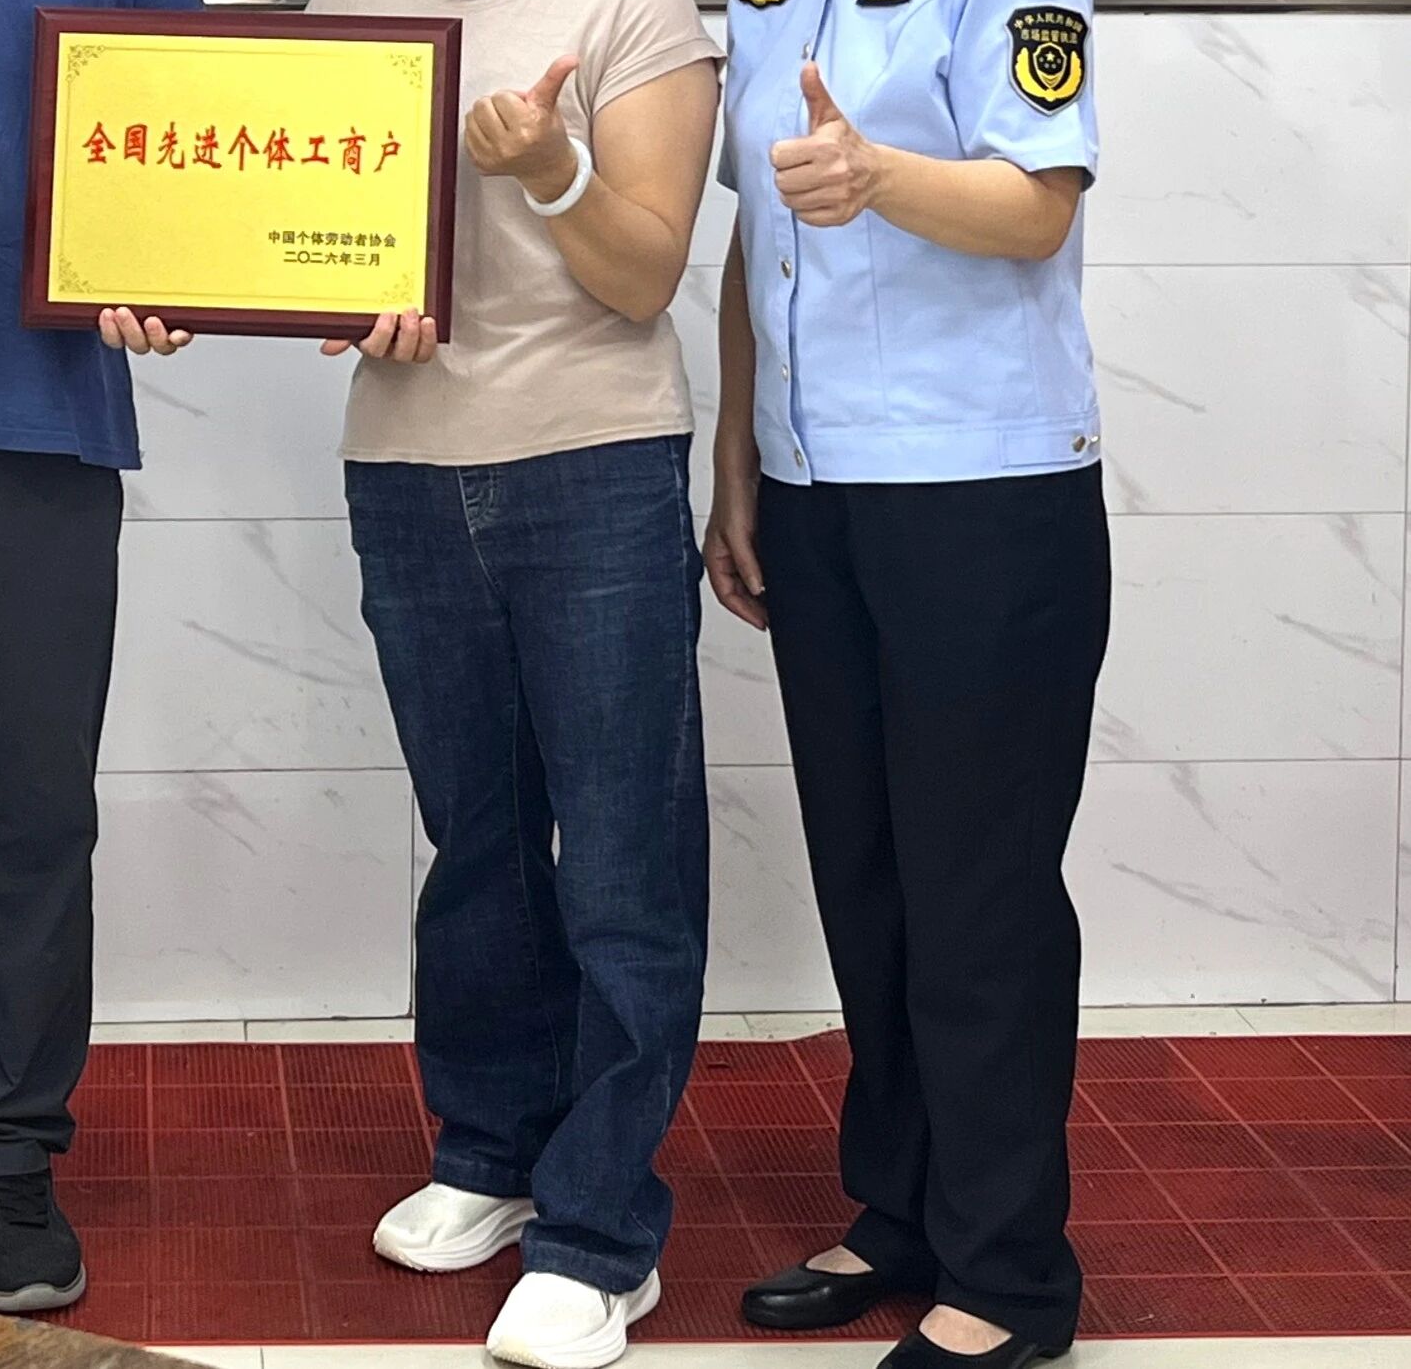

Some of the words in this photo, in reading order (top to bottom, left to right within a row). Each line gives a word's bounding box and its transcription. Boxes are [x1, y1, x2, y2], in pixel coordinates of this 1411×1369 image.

[82, 121, 403, 175] 全国先进个体工商户
[267, 229, 397, 248] 中国个体劳动者协会
